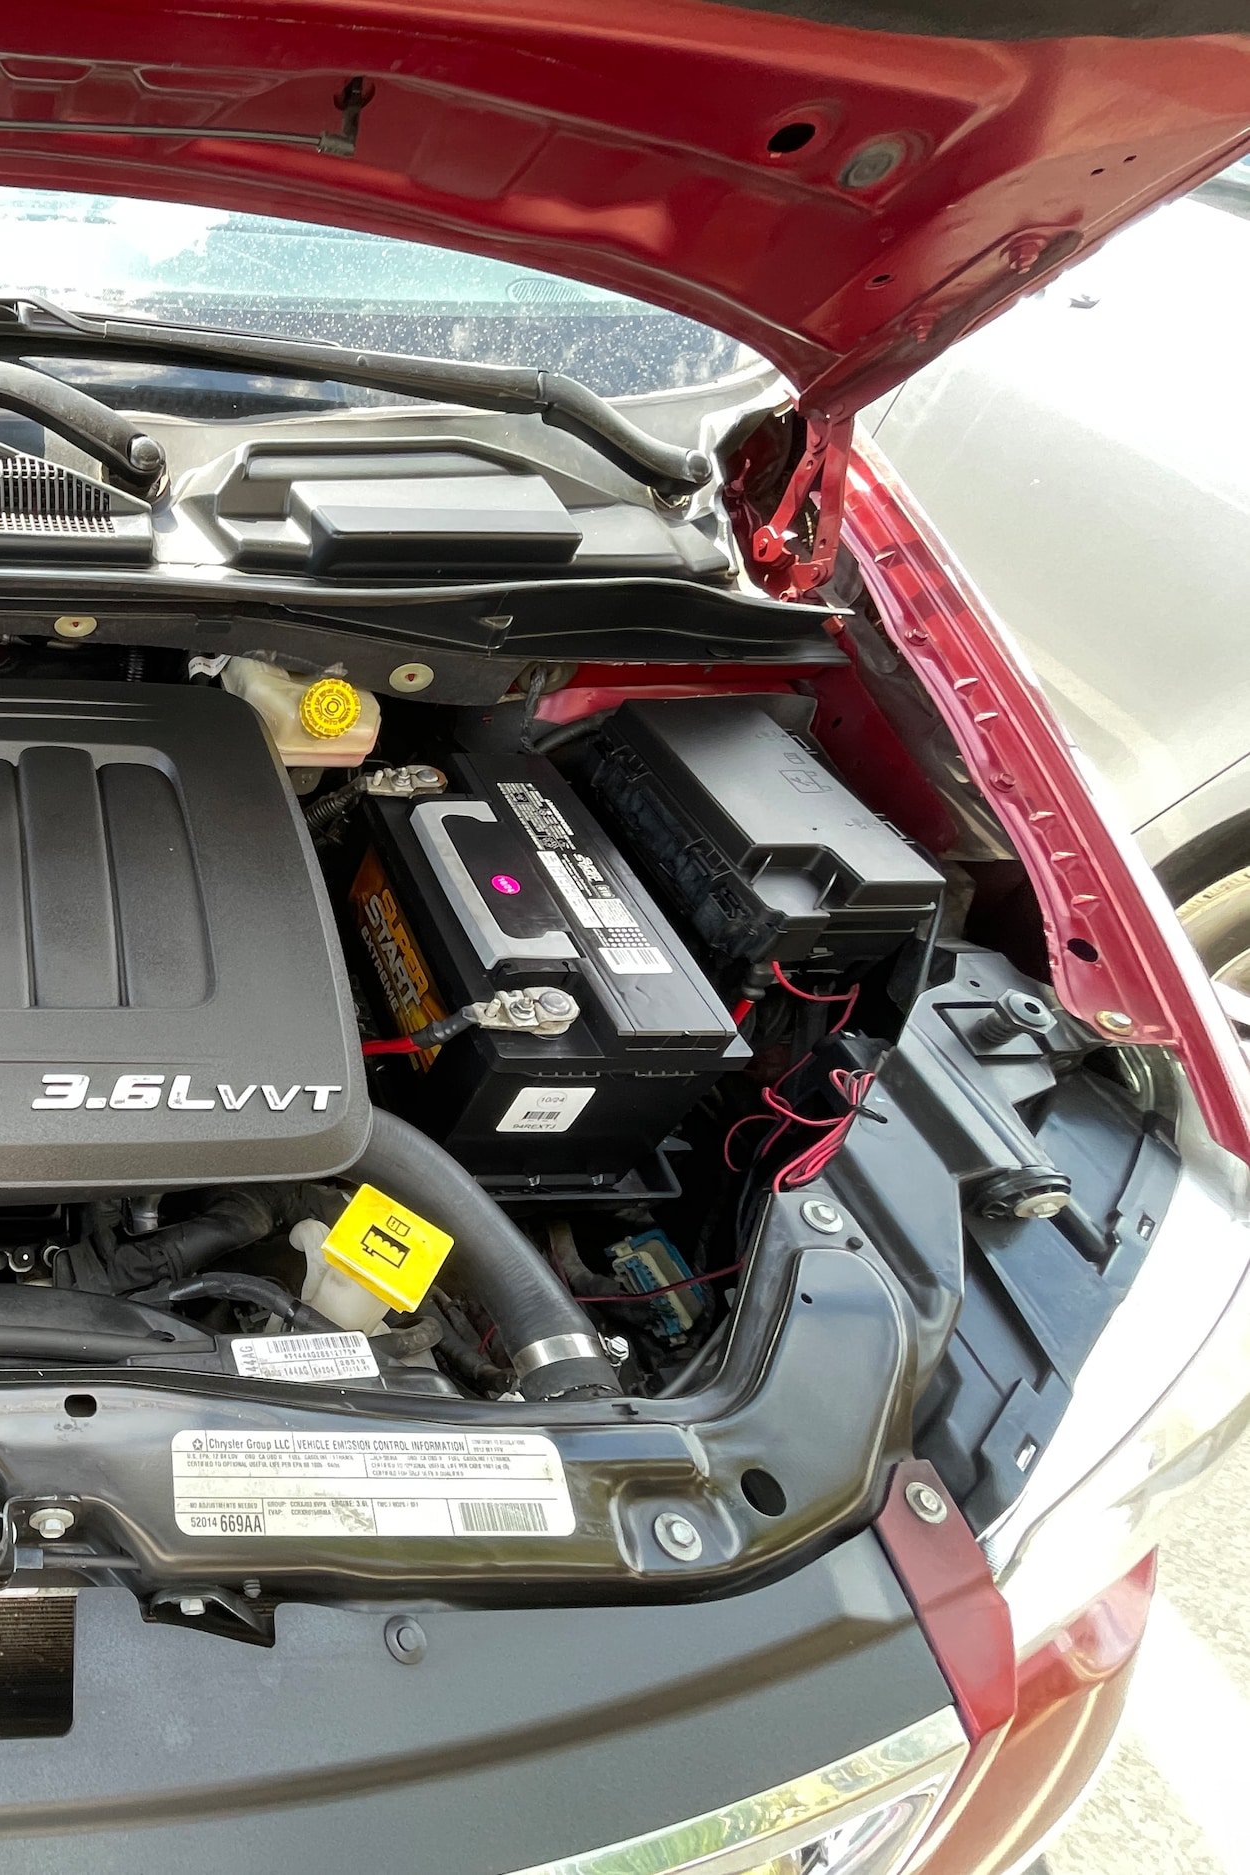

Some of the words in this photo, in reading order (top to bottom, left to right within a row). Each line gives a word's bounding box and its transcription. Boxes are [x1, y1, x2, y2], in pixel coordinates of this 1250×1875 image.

[364, 894, 421, 1007] START
[382, 888, 429, 998] SUPER
[361, 925, 400, 1013] EXTREME
[540, 1096, 566, 1104] 10/24
[208, 1438, 244, 1452] Chrysler
[246, 1439, 272, 1451] Group
[274, 1439, 290, 1450] LLC
[297, 1440, 330, 1450] VEHICLE
[332, 1440, 371, 1451] EMISSION
[373, 1440, 410, 1451] CONTROL
[411, 1440, 465, 1452] INFORMATION
[191, 1516, 217, 1527] 52014
[220, 1515, 262, 1532] 669AA
